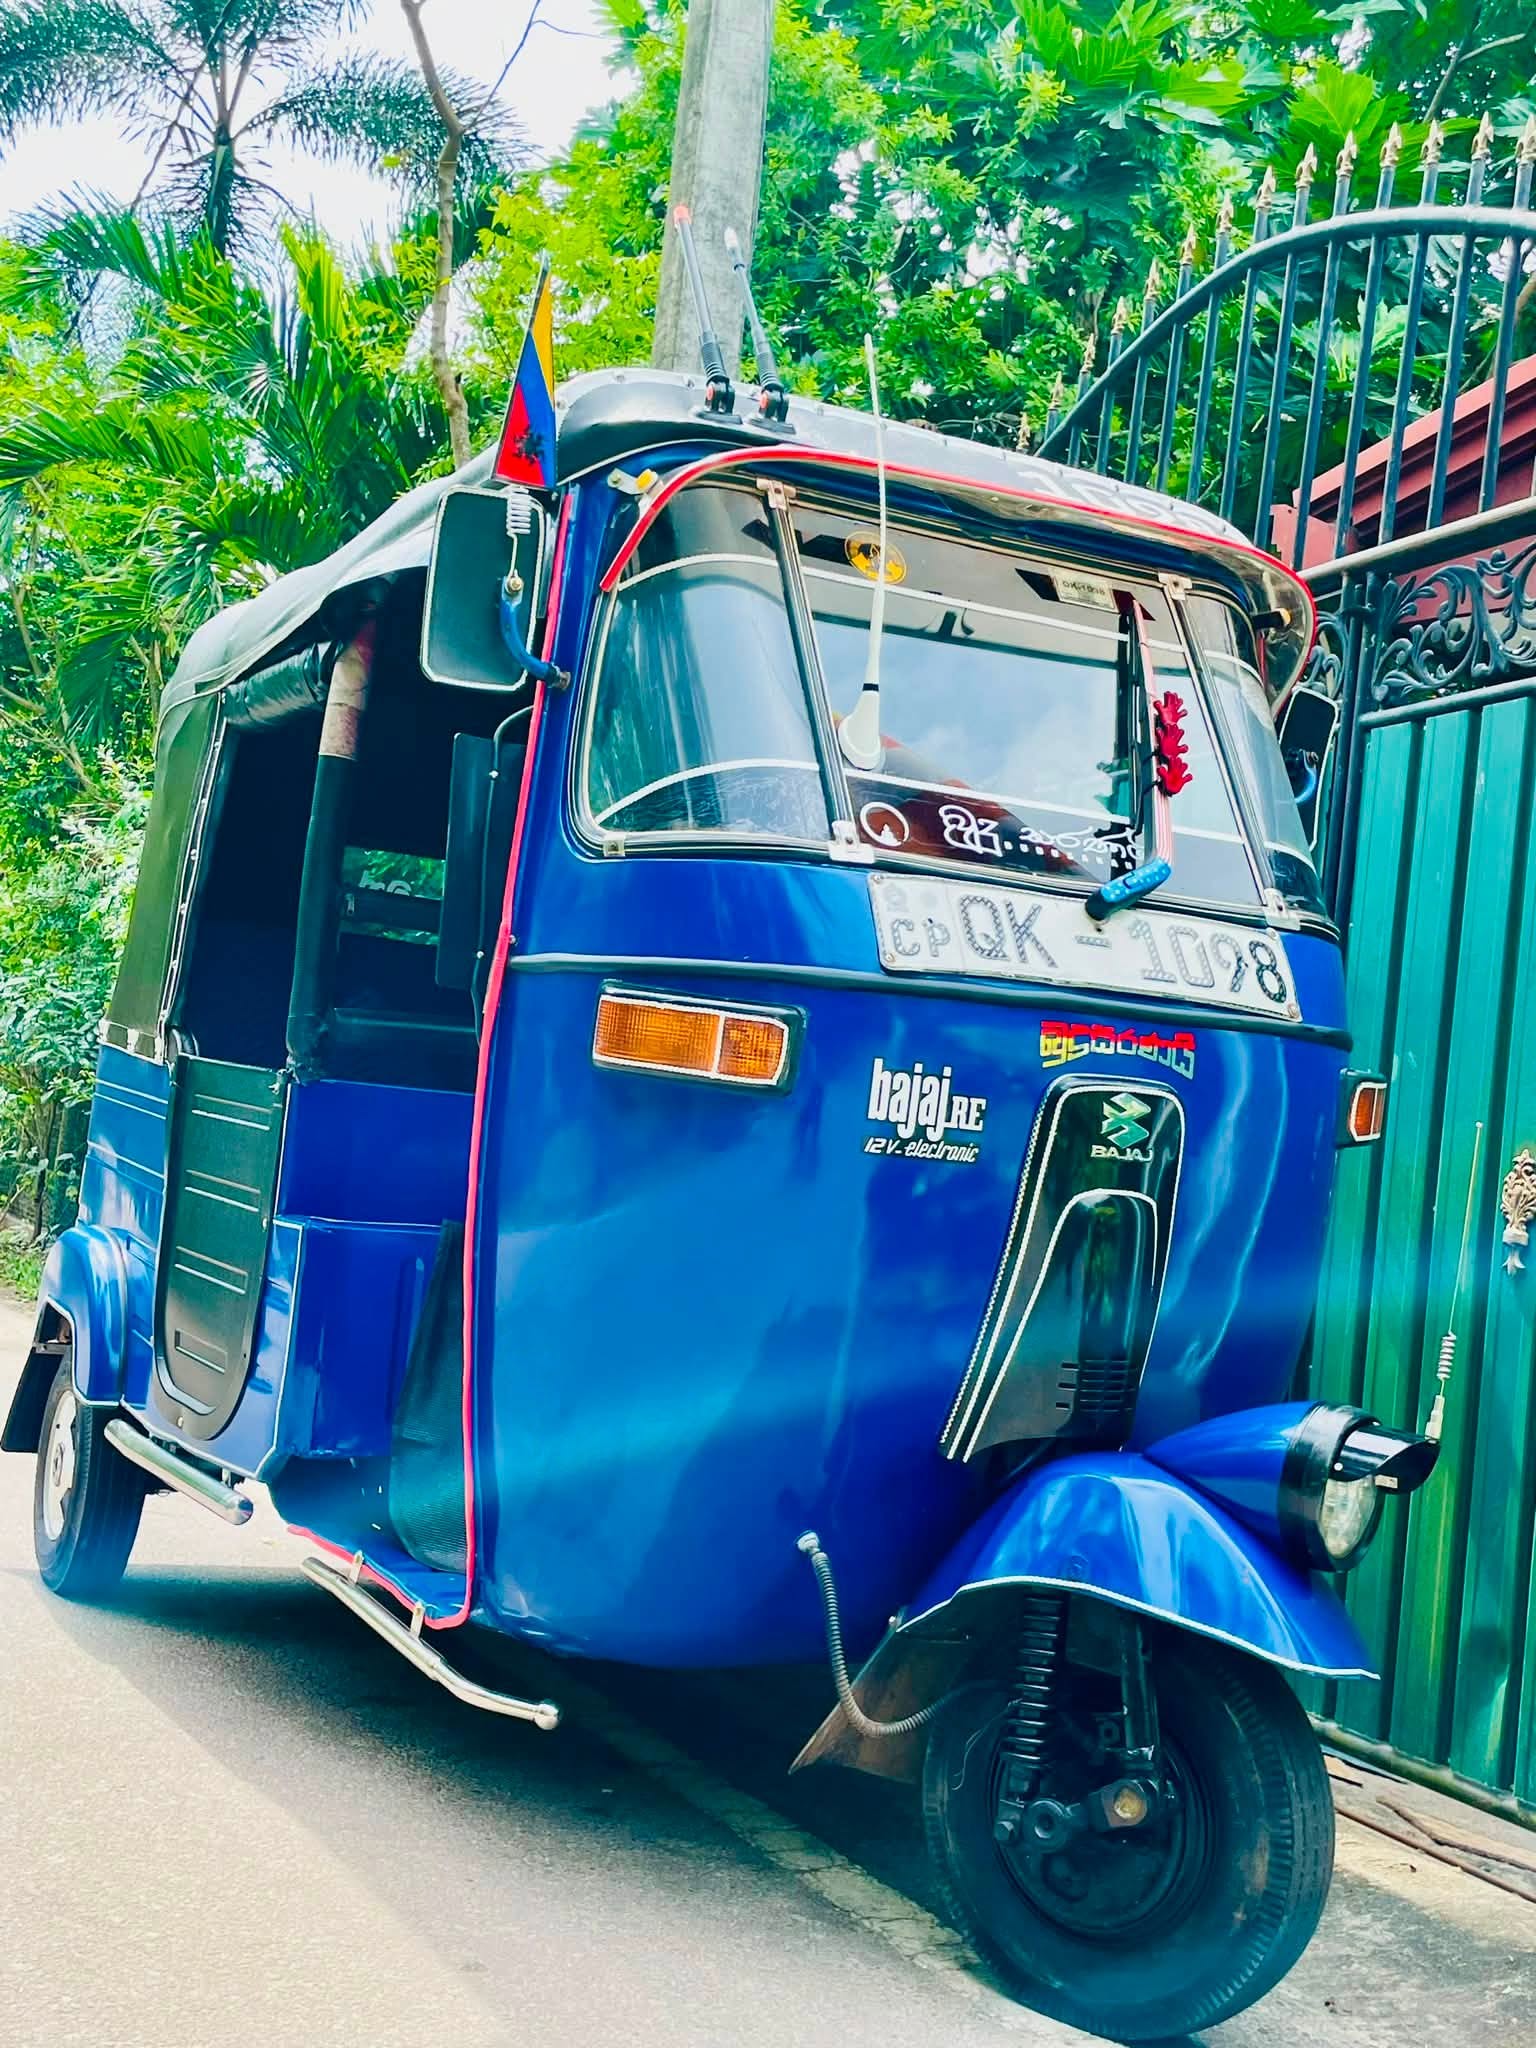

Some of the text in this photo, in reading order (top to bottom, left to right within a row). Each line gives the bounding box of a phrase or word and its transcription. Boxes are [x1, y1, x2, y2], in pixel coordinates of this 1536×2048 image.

[891, 916, 951, 957] CP
[958, 894, 1058, 968] QK
[1128, 918, 1287, 1003] 1098
[867, 1057, 987, 1142] bajaj RE
[1090, 1144, 1154, 1162] BAJAJ
